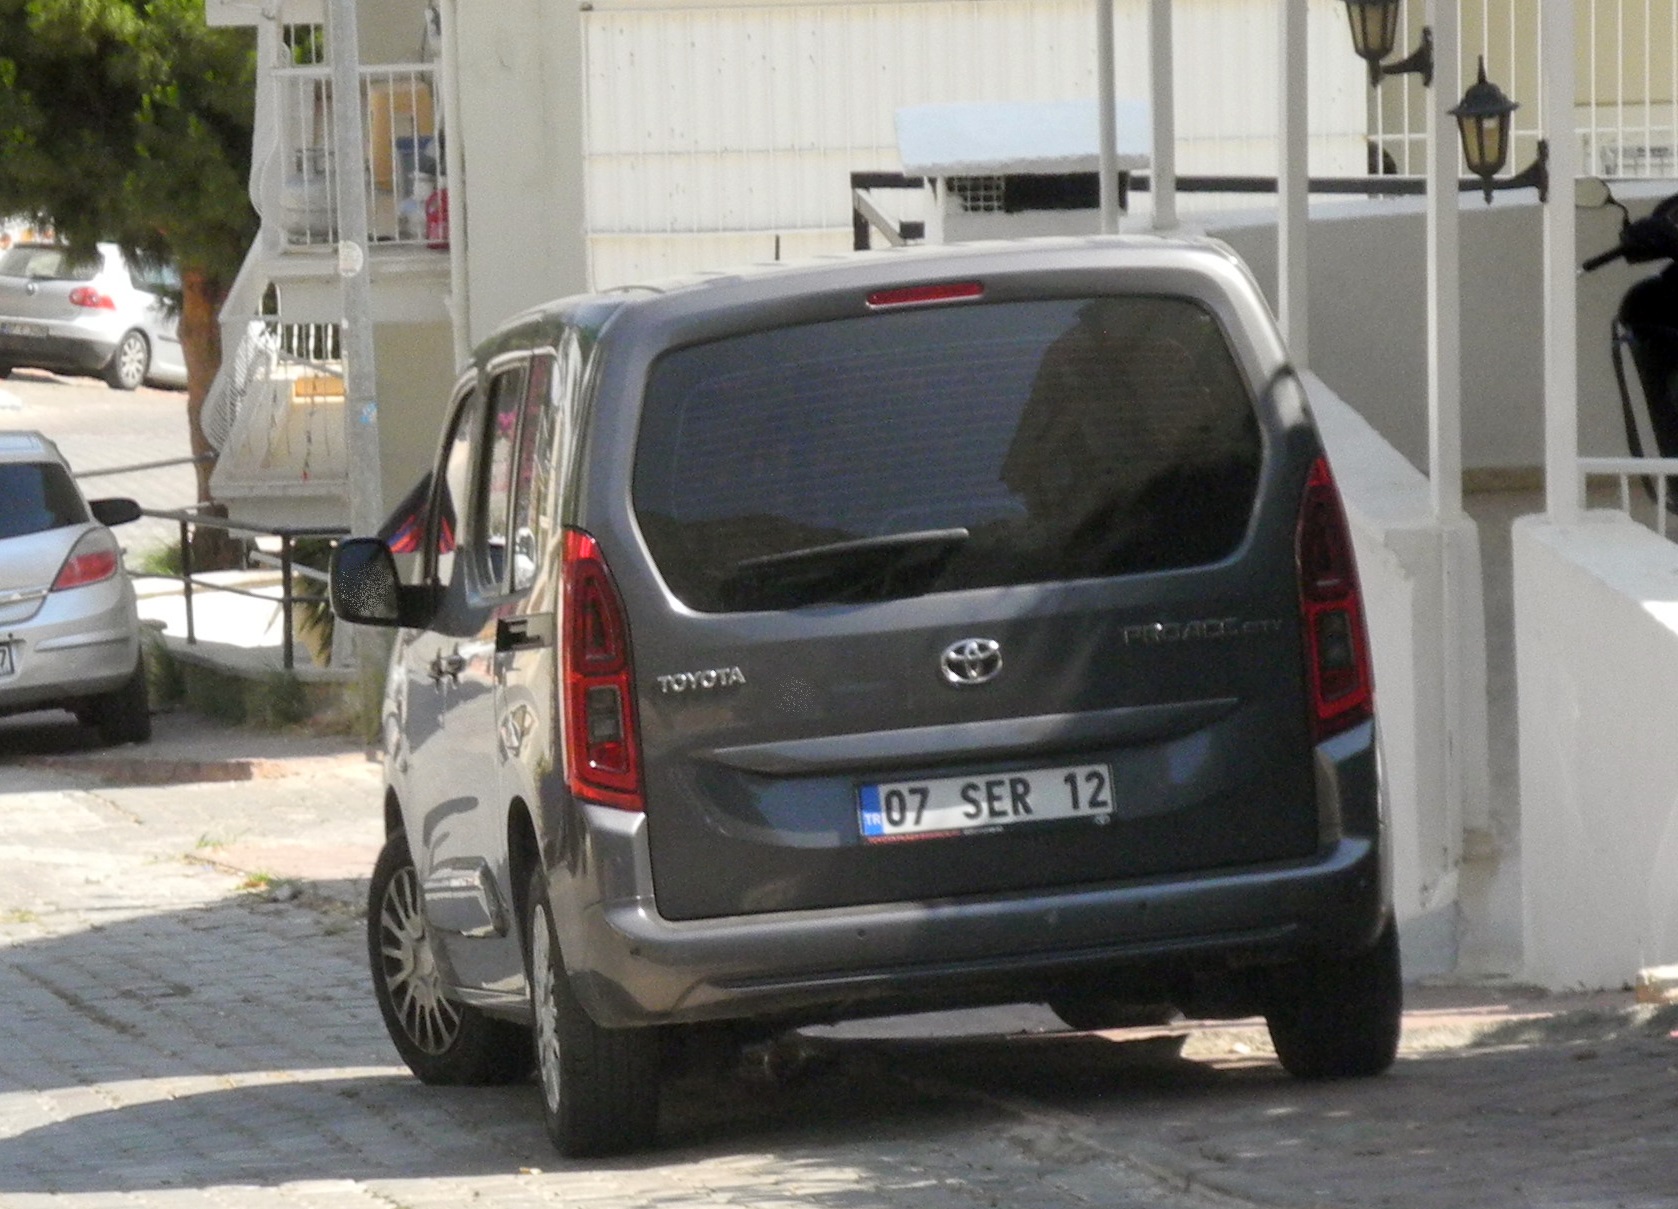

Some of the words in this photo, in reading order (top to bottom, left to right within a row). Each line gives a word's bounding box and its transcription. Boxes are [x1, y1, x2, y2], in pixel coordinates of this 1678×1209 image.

[656, 666, 747, 694] TOYOTA
[863, 812, 882, 826] TR
[884, 786, 931, 828] 07
[959, 777, 1034, 821] SER
[1063, 771, 1110, 811] 12
